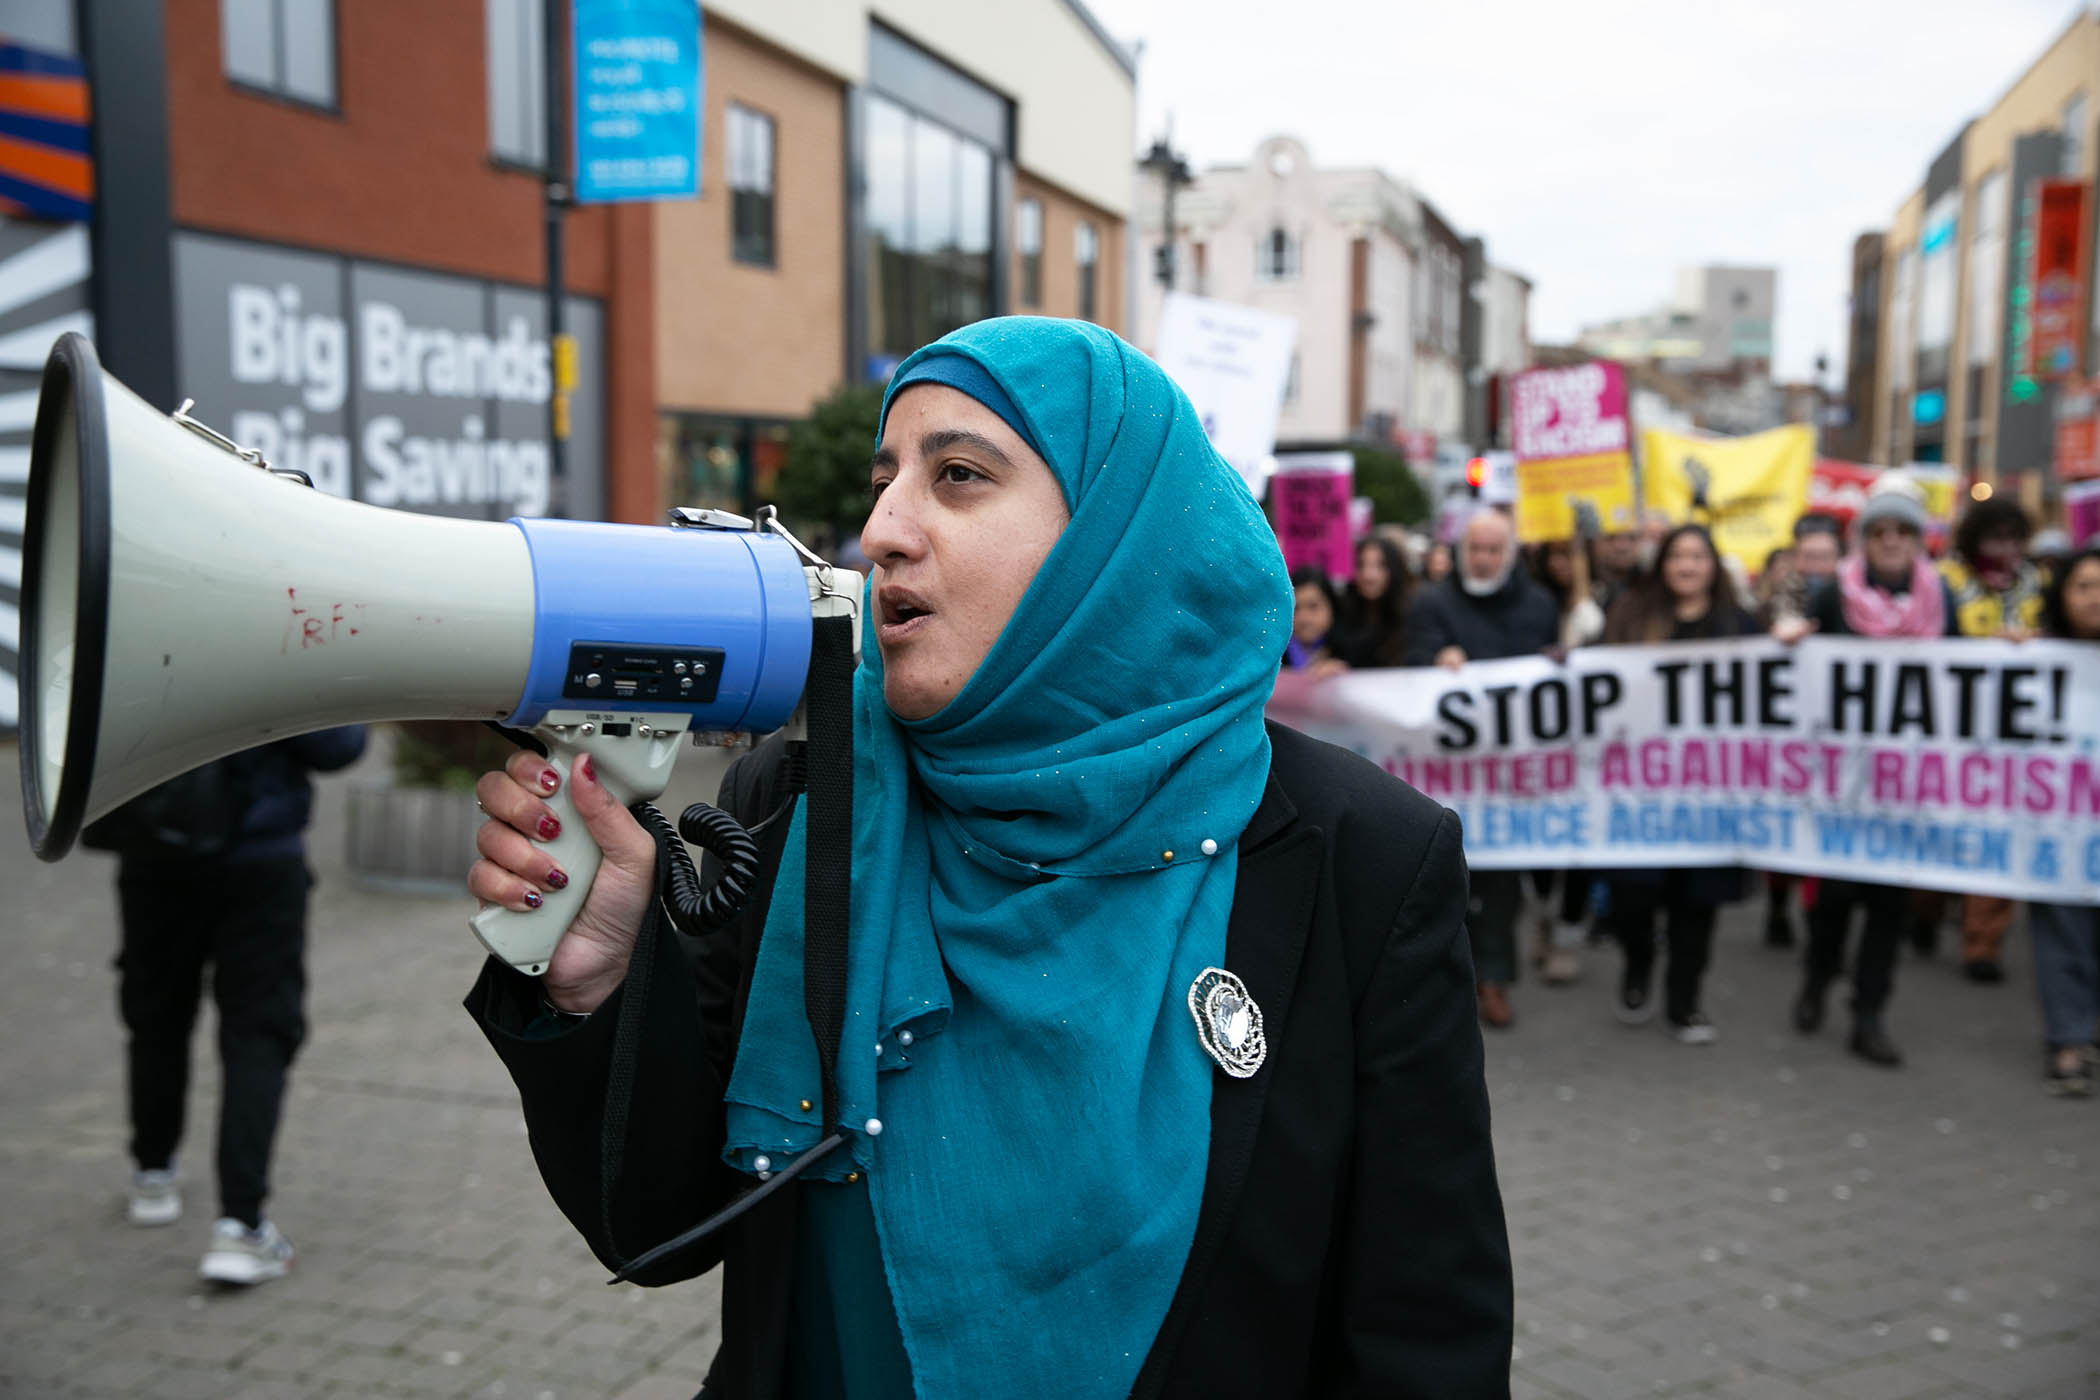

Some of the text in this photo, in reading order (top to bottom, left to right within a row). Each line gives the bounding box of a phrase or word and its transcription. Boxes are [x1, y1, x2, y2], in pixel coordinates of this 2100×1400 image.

[229, 284, 551, 411] Big Brands
[363, 415, 550, 517] Saving
[1437, 659, 2072, 750] STOP THE HATE!
[1602, 737, 1845, 799] AGAINST
[1608, 802, 1795, 850] AGAINST
[1817, 812, 2013, 873] WOMEN
